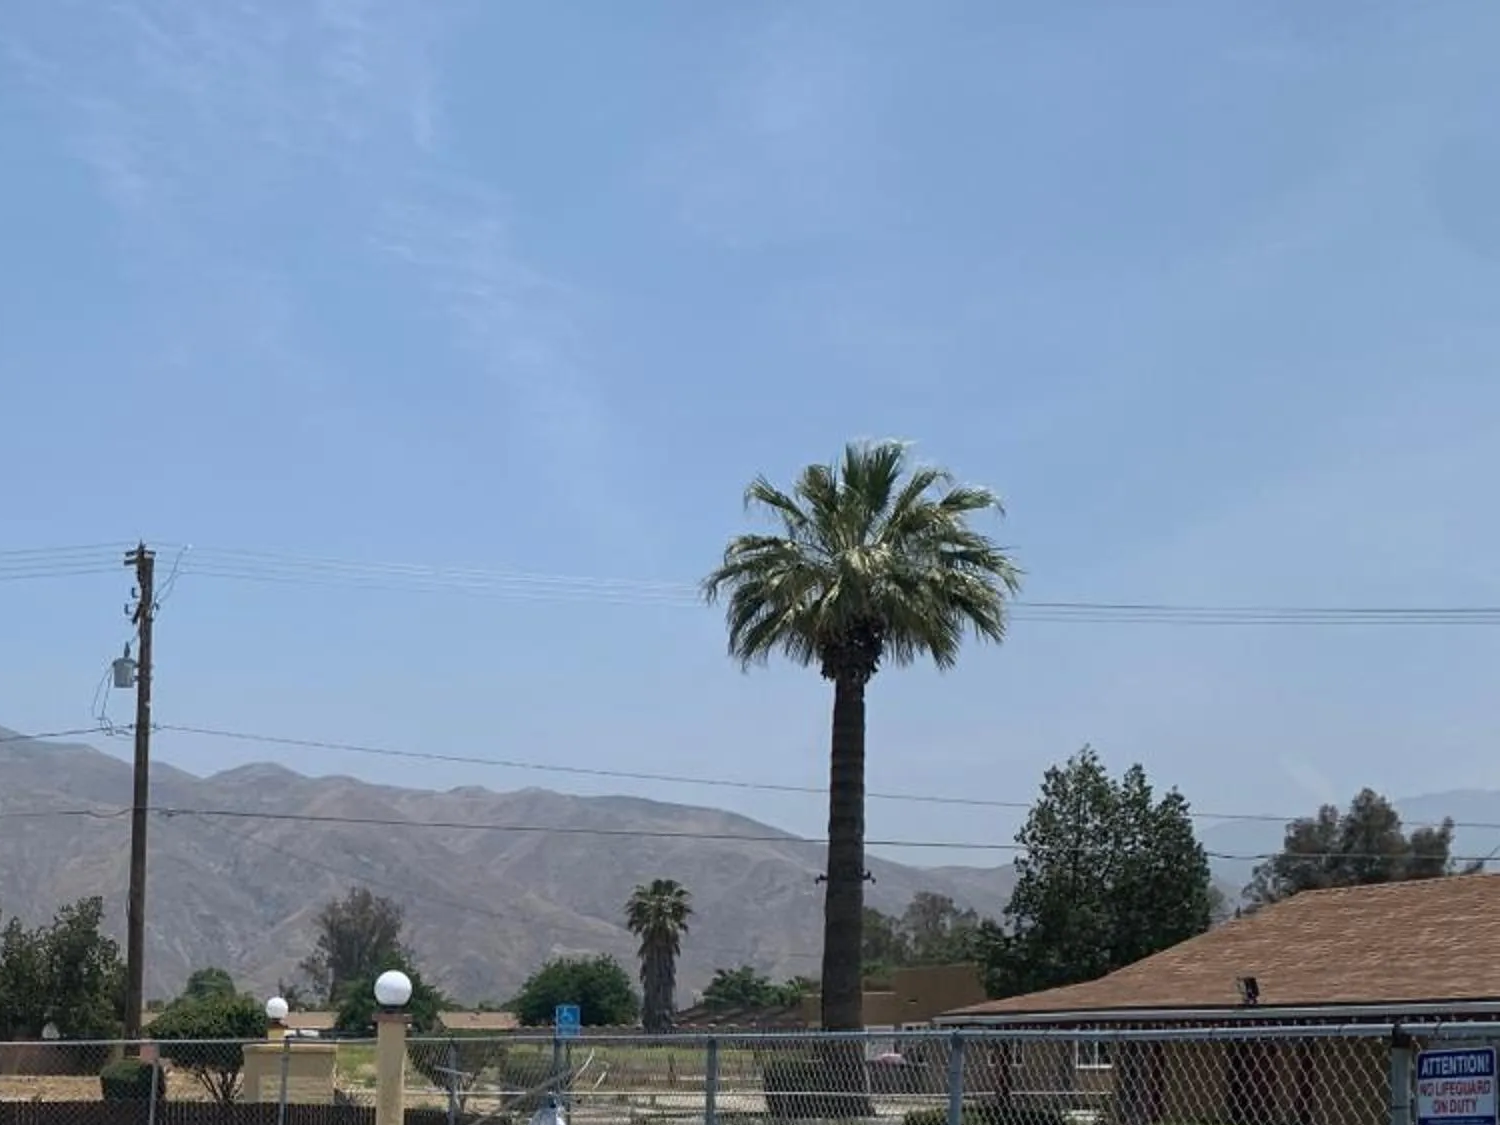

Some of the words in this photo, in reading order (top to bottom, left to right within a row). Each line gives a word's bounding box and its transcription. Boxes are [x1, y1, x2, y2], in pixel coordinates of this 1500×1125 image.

[1421, 1054, 1490, 1076] ATTENTION!
[1436, 1080, 1491, 1096] LIFEGUARD
[1433, 1100, 1449, 1114] ON
[1450, 1099, 1477, 1113] DUTY
